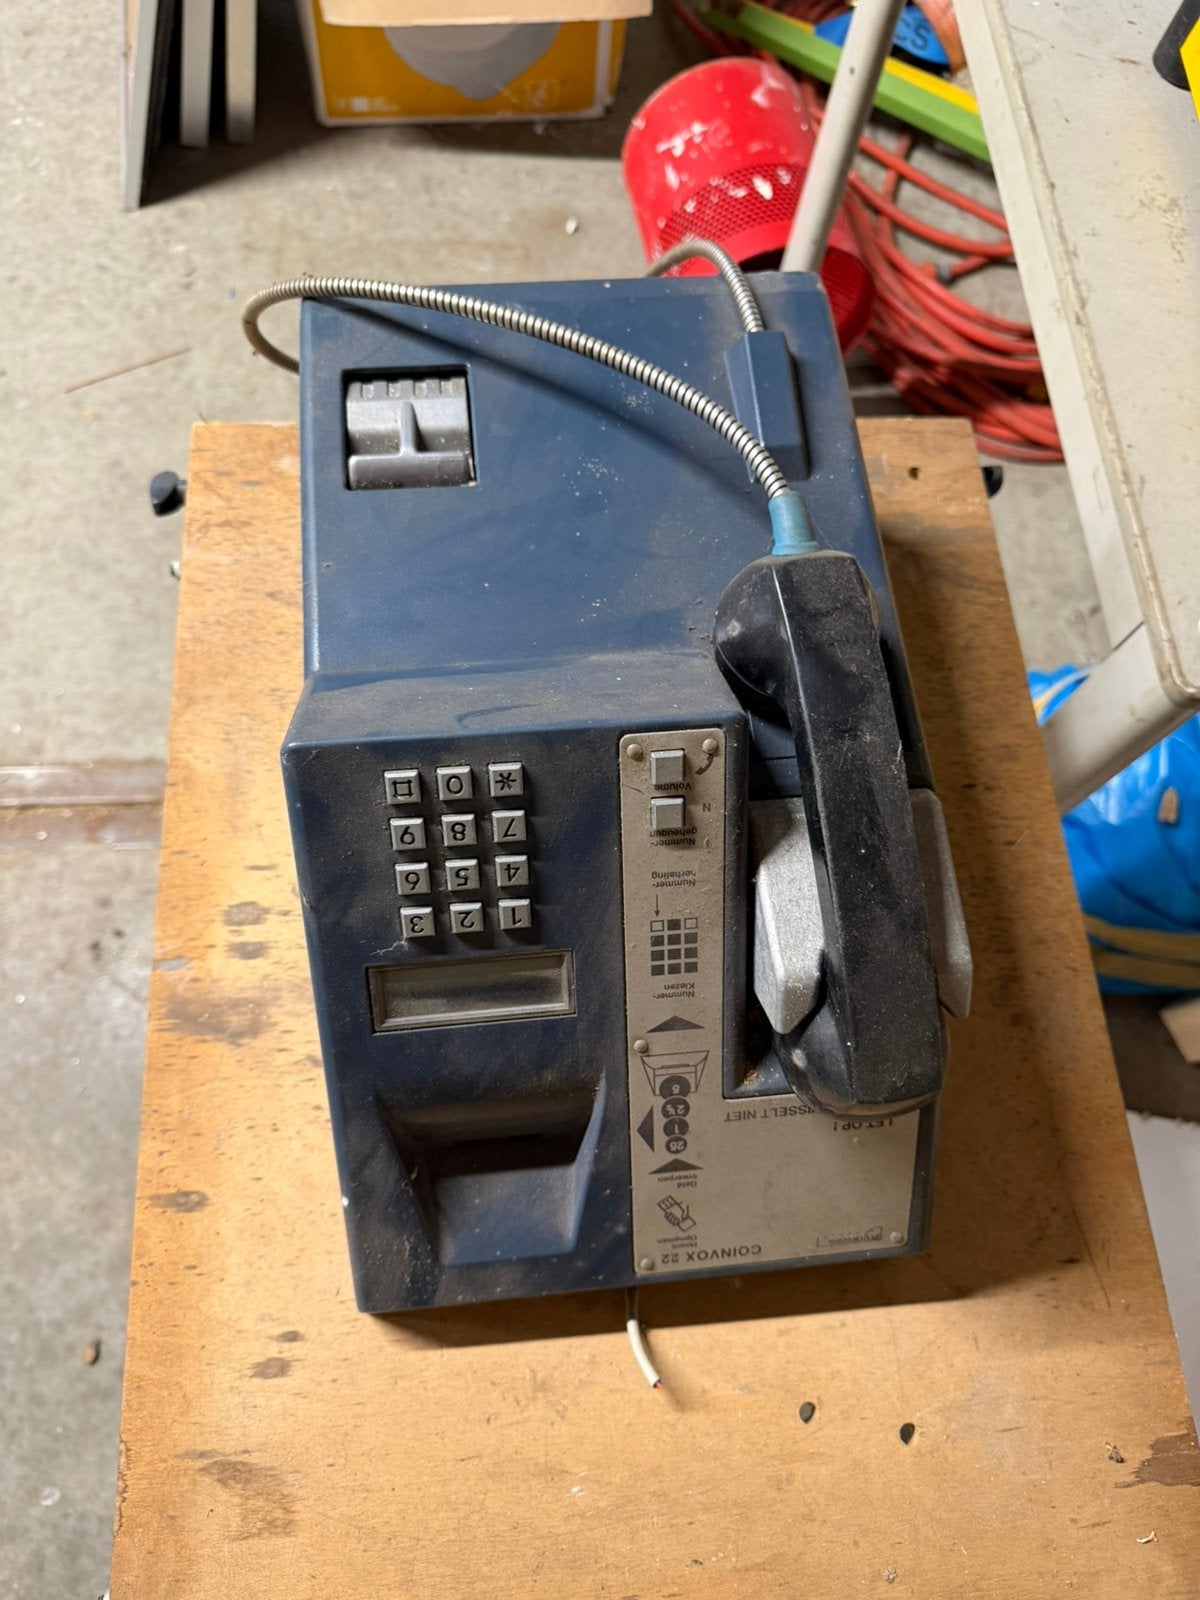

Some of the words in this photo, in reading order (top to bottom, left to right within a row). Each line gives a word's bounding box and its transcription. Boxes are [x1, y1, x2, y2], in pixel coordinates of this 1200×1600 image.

[654, 782, 692, 791] Volume
[702, 803, 711, 812] N
[450, 822, 466, 842] 8
[502, 818, 517, 837] 7
[399, 826, 415, 845] 9
[455, 868, 469, 887] 5
[504, 863, 521, 882] 4
[405, 871, 420, 890] 6
[651, 878, 696, 888] Nummer-
[458, 911, 475, 929] 2
[510, 906, 523, 926] 1
[410, 915, 424, 934] 3
[663, 981, 695, 991] Kiezen
[652, 990, 696, 1000] Nummer-
[672, 1084, 680, 1094] 5
[723, 1110, 757, 1122] NIET
[669, 1141, 685, 1151] 25
[657, 1174, 698, 1182] Inwerpen
[676, 1181, 698, 1189] Geld
[661, 1253, 680, 1264] 22
[685, 1244, 762, 1262] COINVOX
